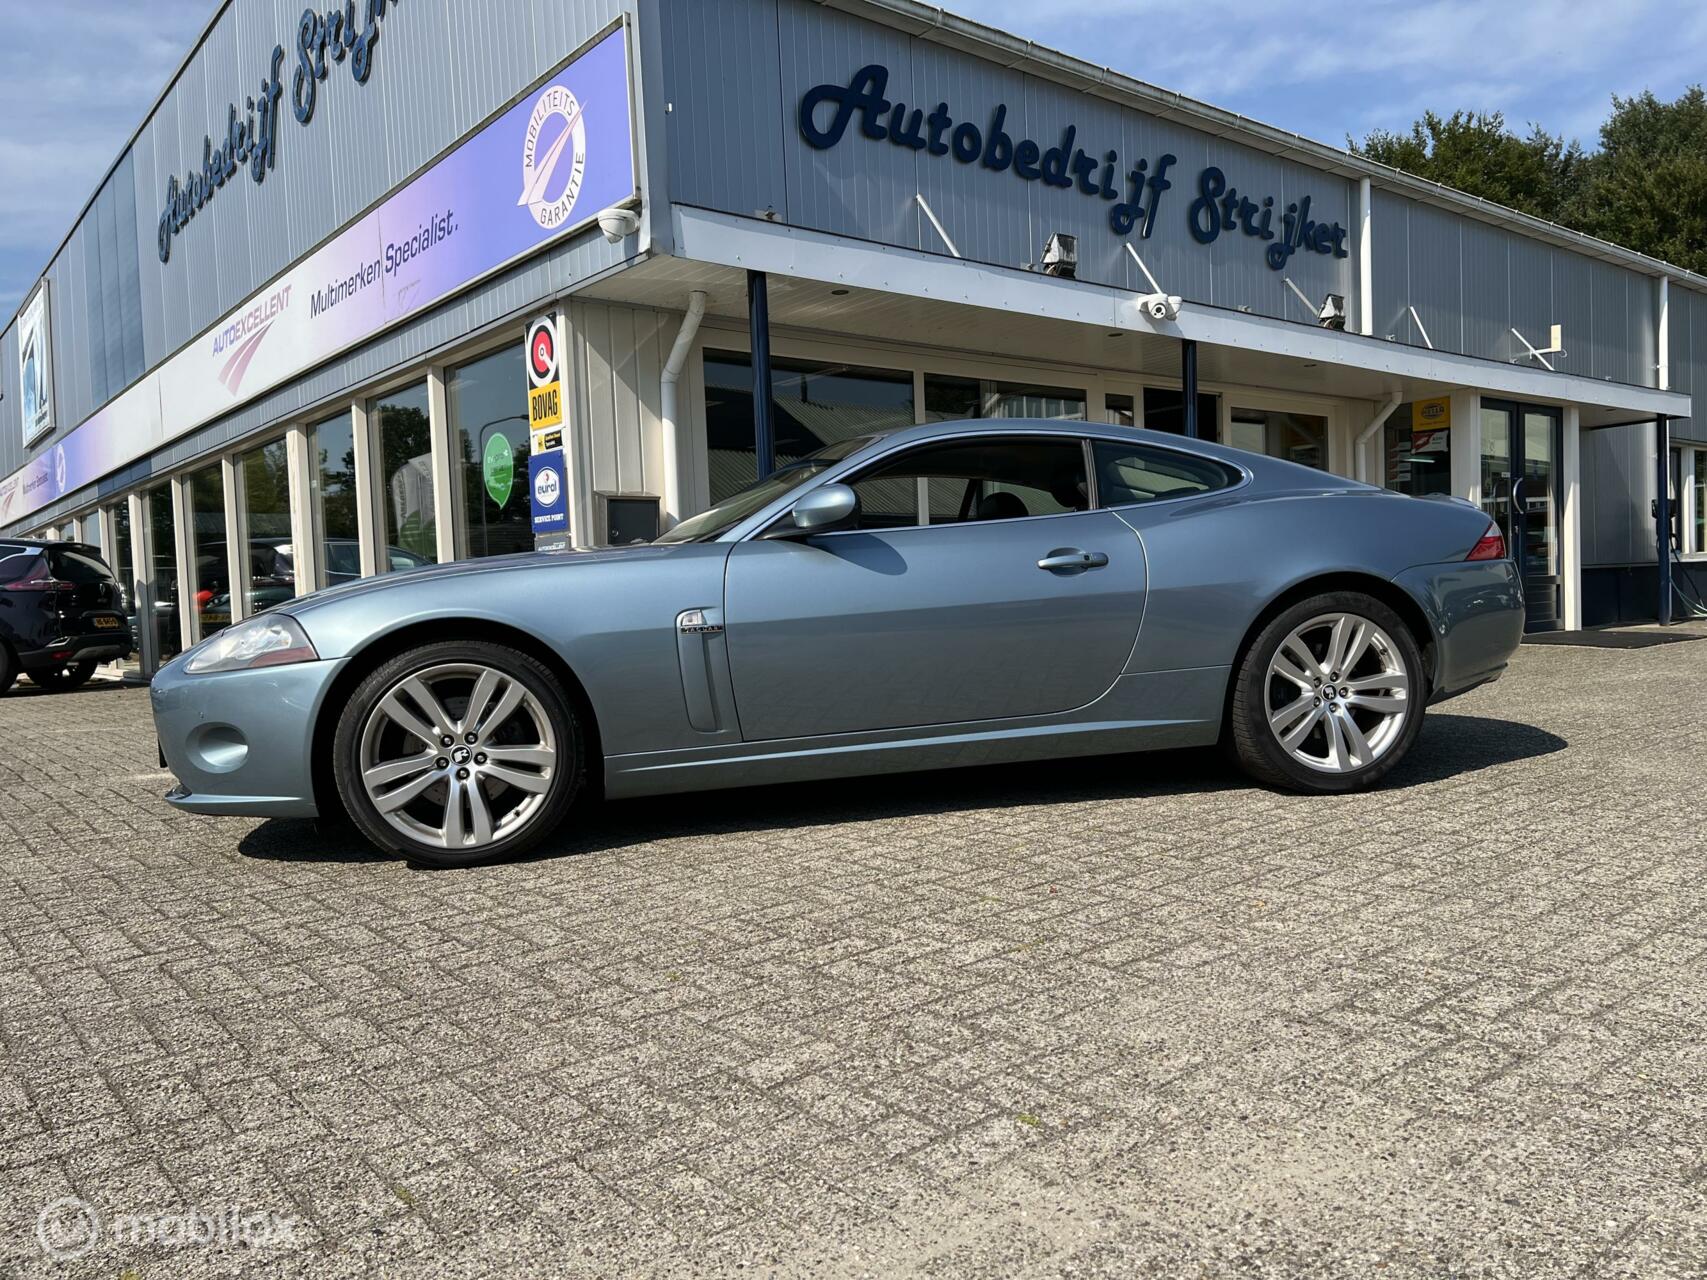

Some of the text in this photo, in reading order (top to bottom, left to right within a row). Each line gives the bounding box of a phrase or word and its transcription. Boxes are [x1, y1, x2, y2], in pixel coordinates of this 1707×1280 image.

[157, 0, 398, 263] Autobedrijf Strij
[525, 90, 575, 168] MOBILITEITS
[800, 64, 1349, 271] Autobedrijf Strijker
[540, 152, 585, 226] GARANTIE
[310, 208, 459, 319] Multimerken Specialist.
[212, 284, 292, 357] AUTOEXCELLENT
[532, 389, 558, 421] BOVAG
